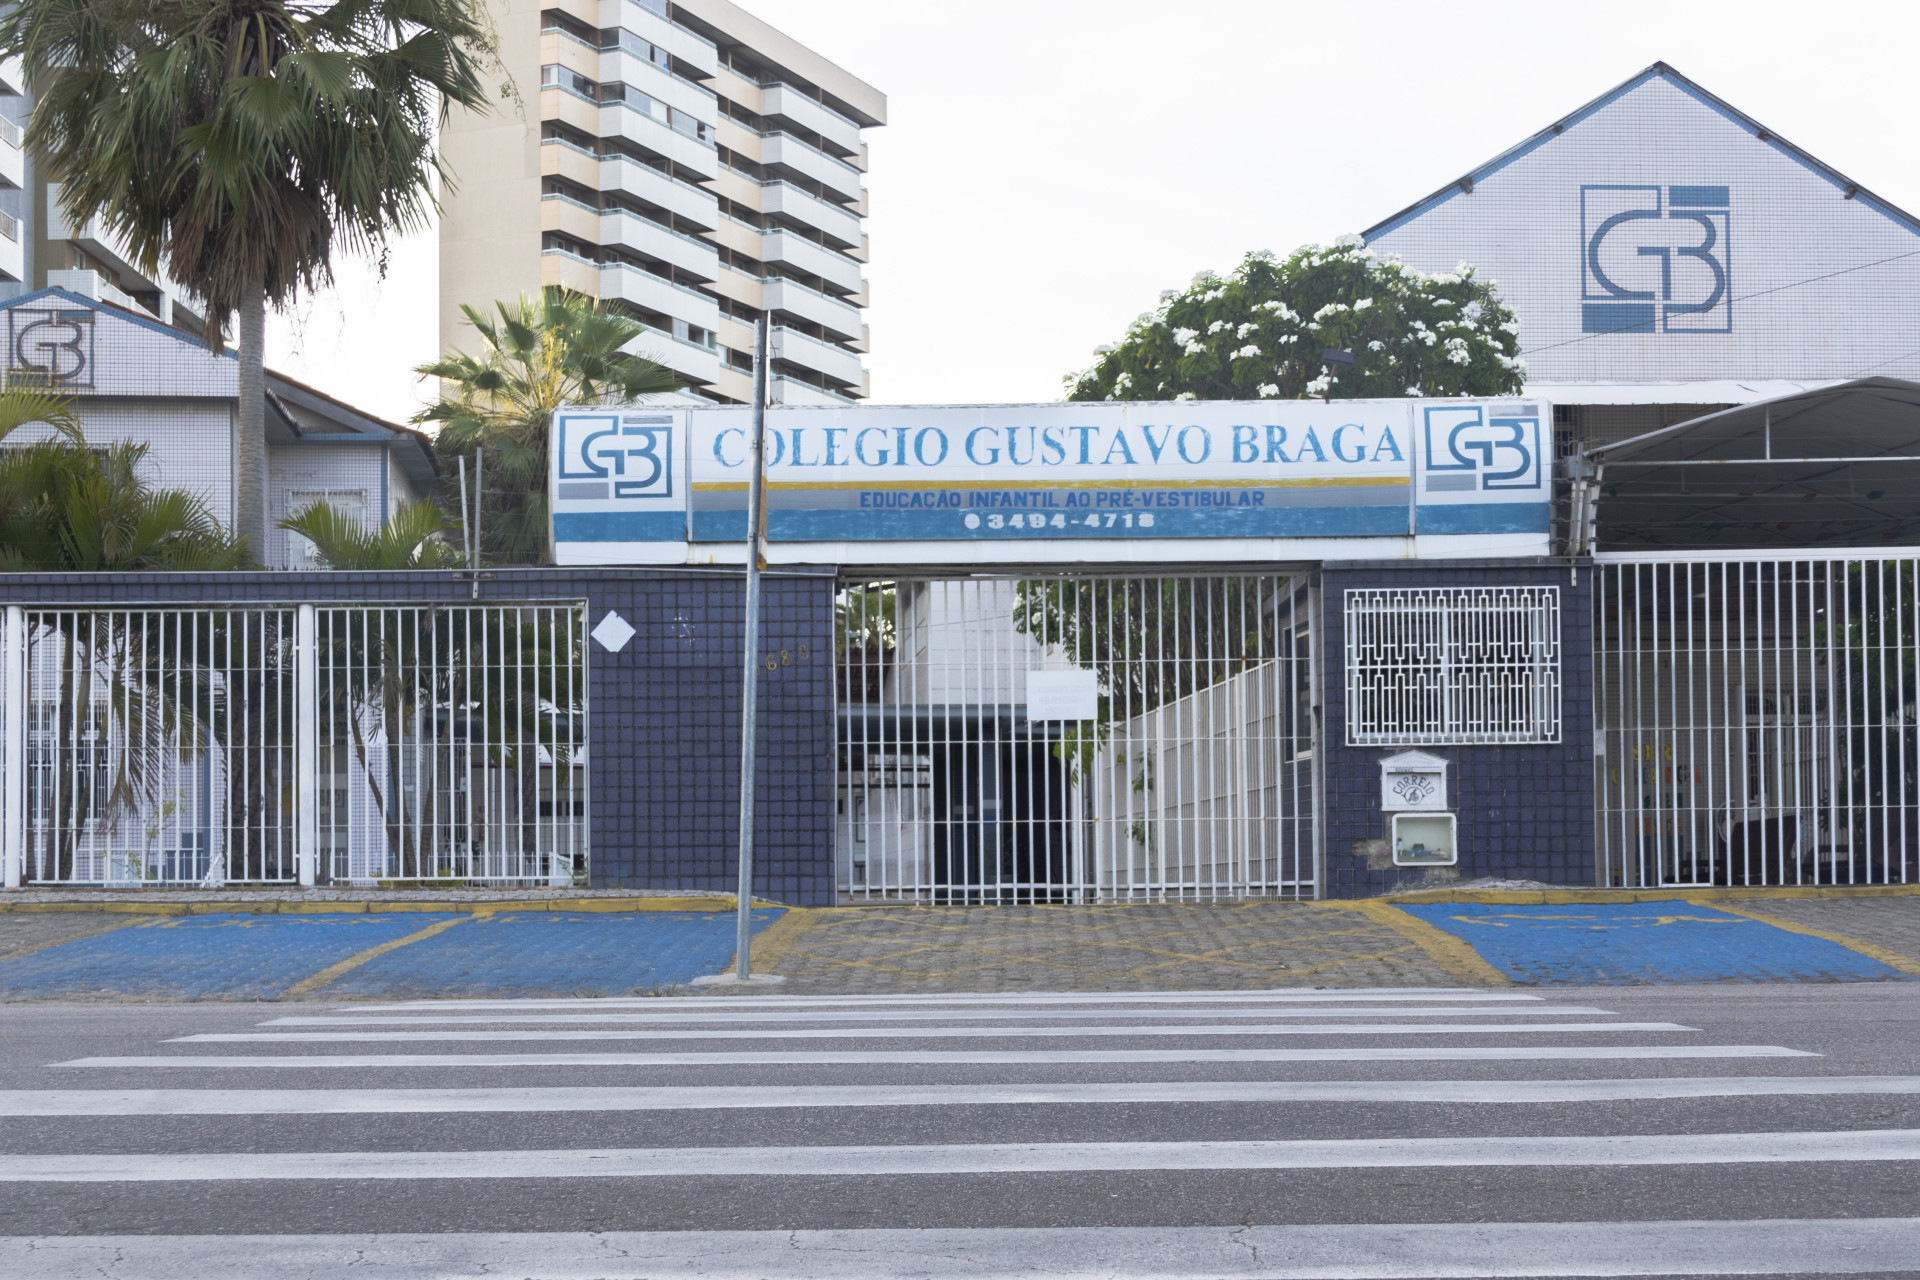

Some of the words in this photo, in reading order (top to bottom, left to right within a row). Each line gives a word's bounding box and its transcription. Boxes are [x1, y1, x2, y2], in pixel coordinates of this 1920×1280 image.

[964, 425, 1212, 466] GUSTAVO
[1231, 423, 1406, 464] BRAGA
[860, 489, 962, 510] EDUCAÇÃO
[969, 491, 1059, 508] INFANTIL
[1065, 491, 1091, 508] AO
[1096, 489, 1265, 508] PRÉ-VESTIBULAR
[987, 513, 1155, 529] 3494-4718
[757, 644, 810, 676] 680
[1393, 775, 1435, 795] CORREIO
